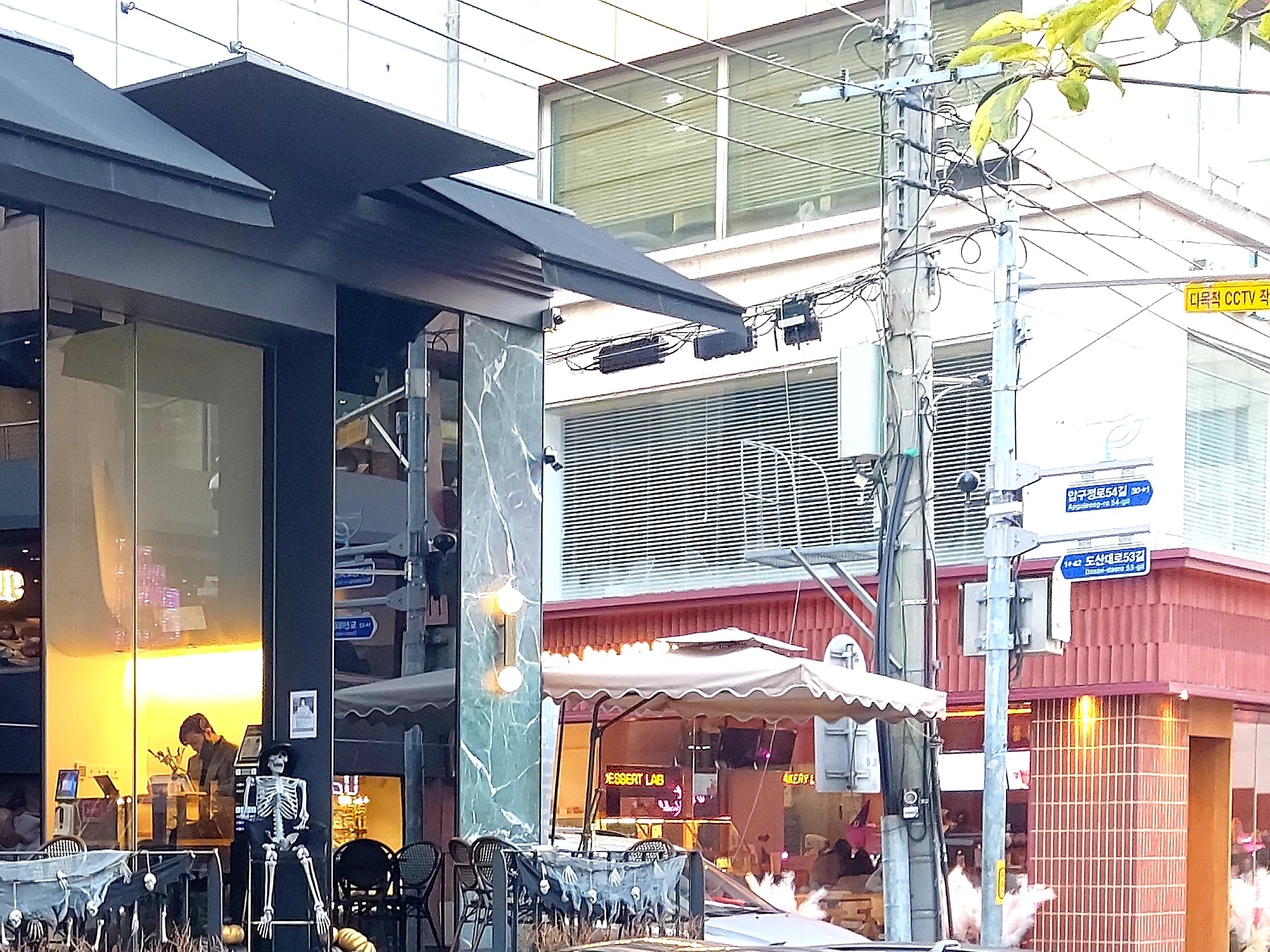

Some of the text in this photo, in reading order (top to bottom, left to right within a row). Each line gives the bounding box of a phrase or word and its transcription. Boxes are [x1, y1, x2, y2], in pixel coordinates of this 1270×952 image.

[1190, 290, 1220, 308] 다목적
[1225, 290, 1256, 306] CCTV
[1068, 485, 1128, 502] 압구정로54길
[1085, 550, 1145, 566] 도산대로53길
[645, 773, 665, 786] LAB
